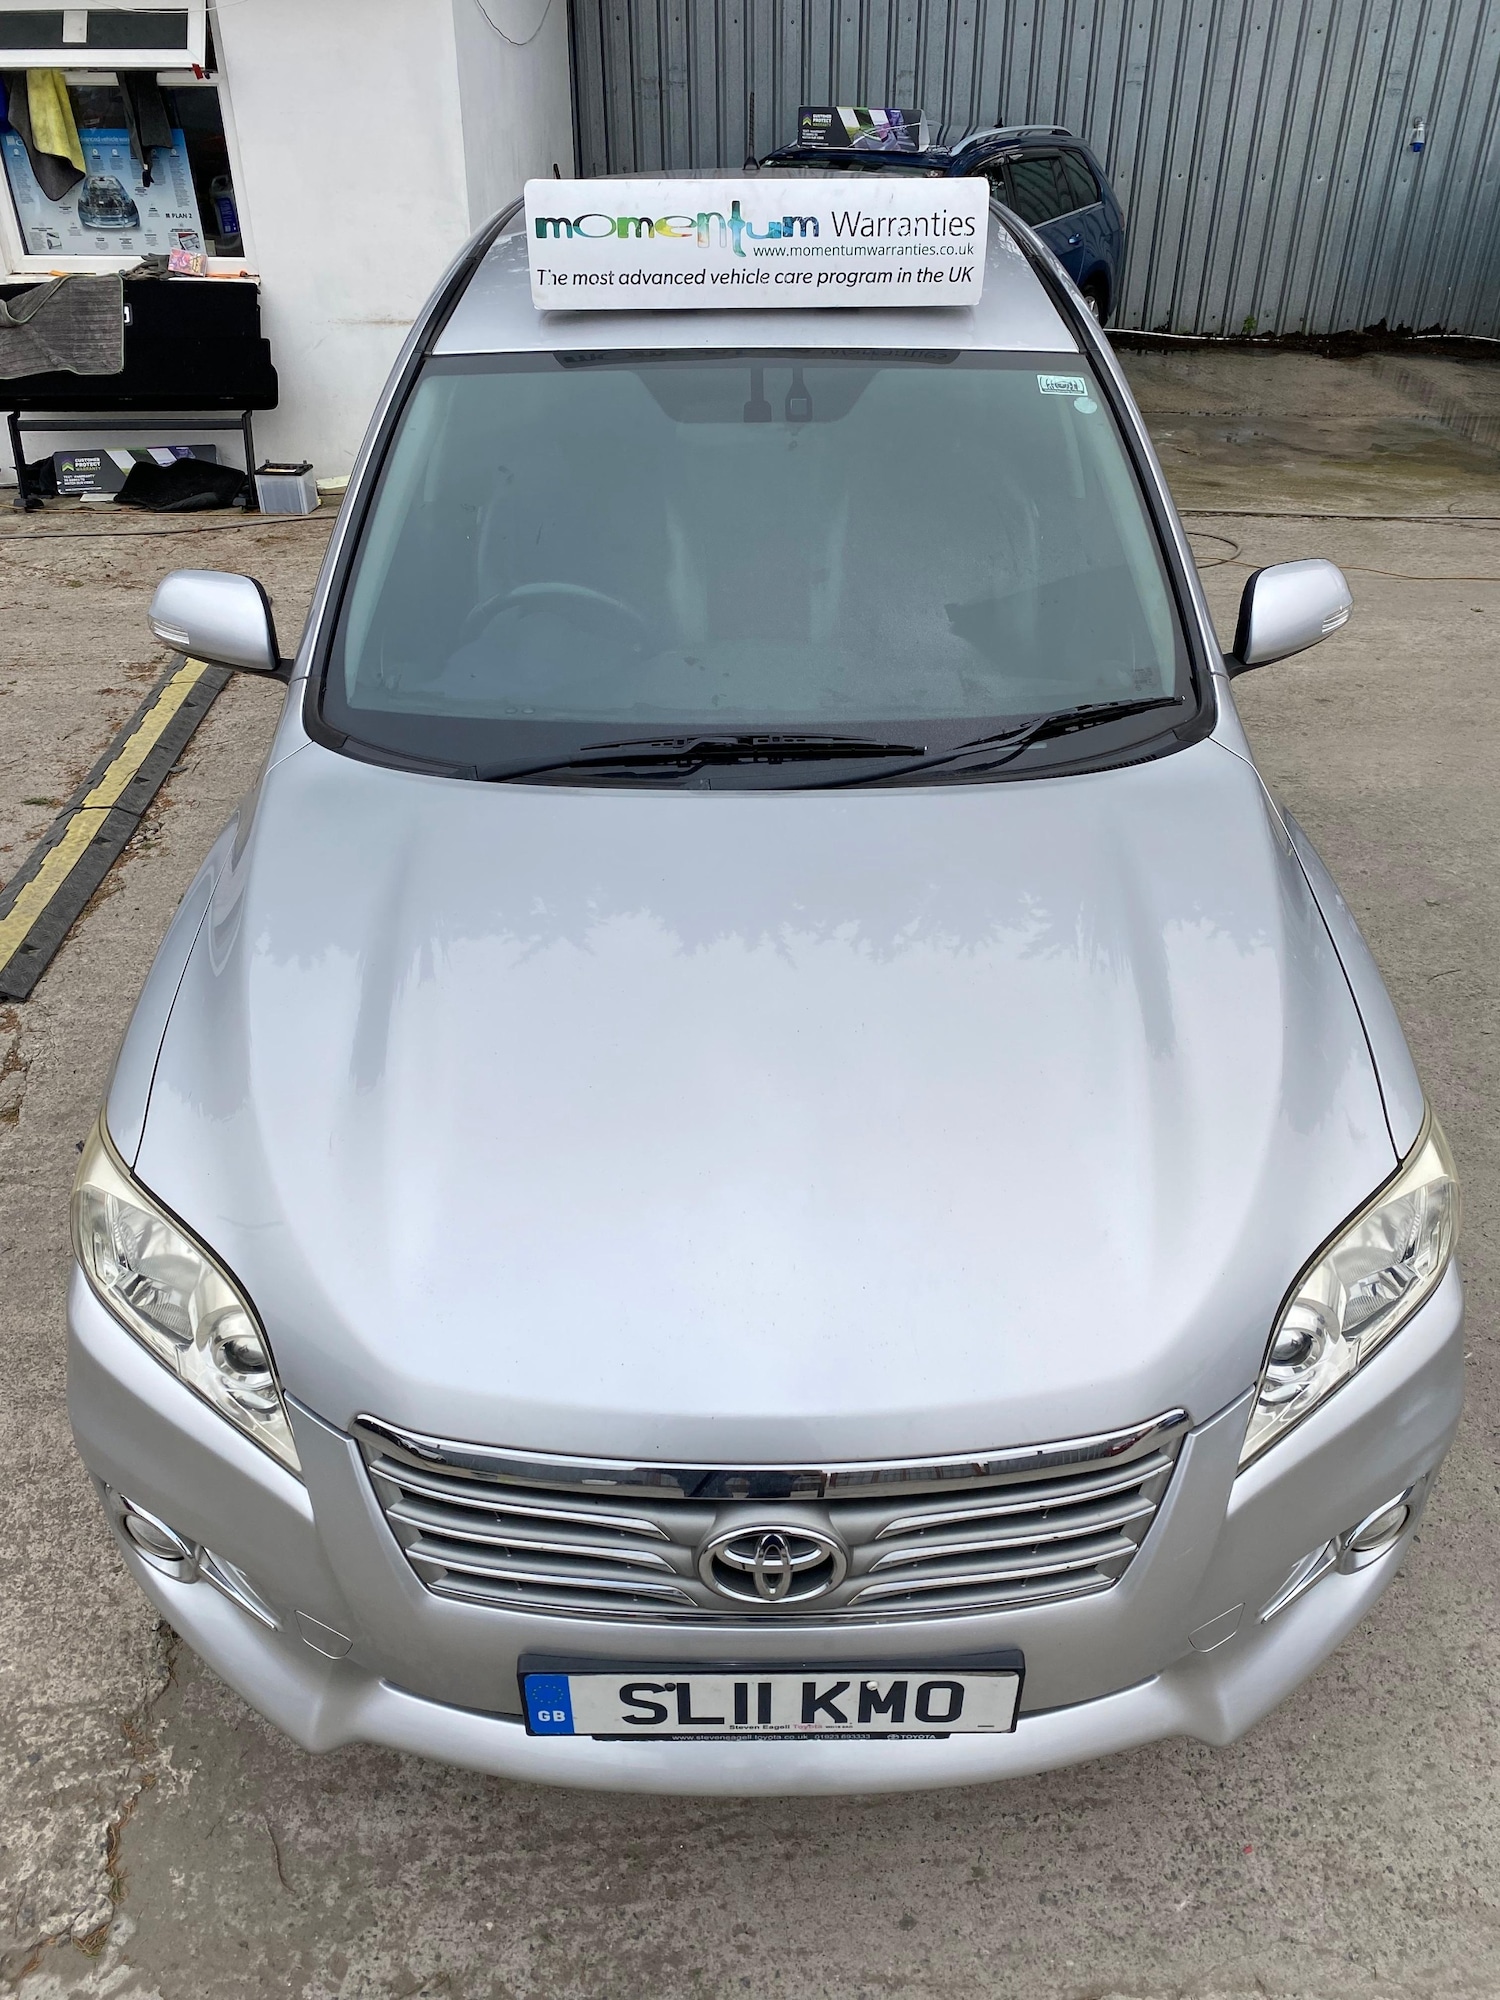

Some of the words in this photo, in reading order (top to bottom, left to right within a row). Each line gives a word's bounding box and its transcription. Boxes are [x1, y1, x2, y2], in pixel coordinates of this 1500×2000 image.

[535, 200, 819, 257] momentum
[831, 209, 976, 238] Warranties
[753, 243, 975, 257] www.momentumwarranties.co.uk
[537, 269, 568, 286] The
[572, 270, 615, 286] most
[618, 269, 705, 286] advanced
[711, 268, 770, 285] vehicle
[774, 272, 813, 285] care
[816, 271, 893, 288] program
[897, 267, 912, 284] in
[916, 267, 944, 283] the
[948, 266, 975, 283] UK
[801, 1681, 965, 1724] KMO
[538, 1710, 566, 1722] GB
